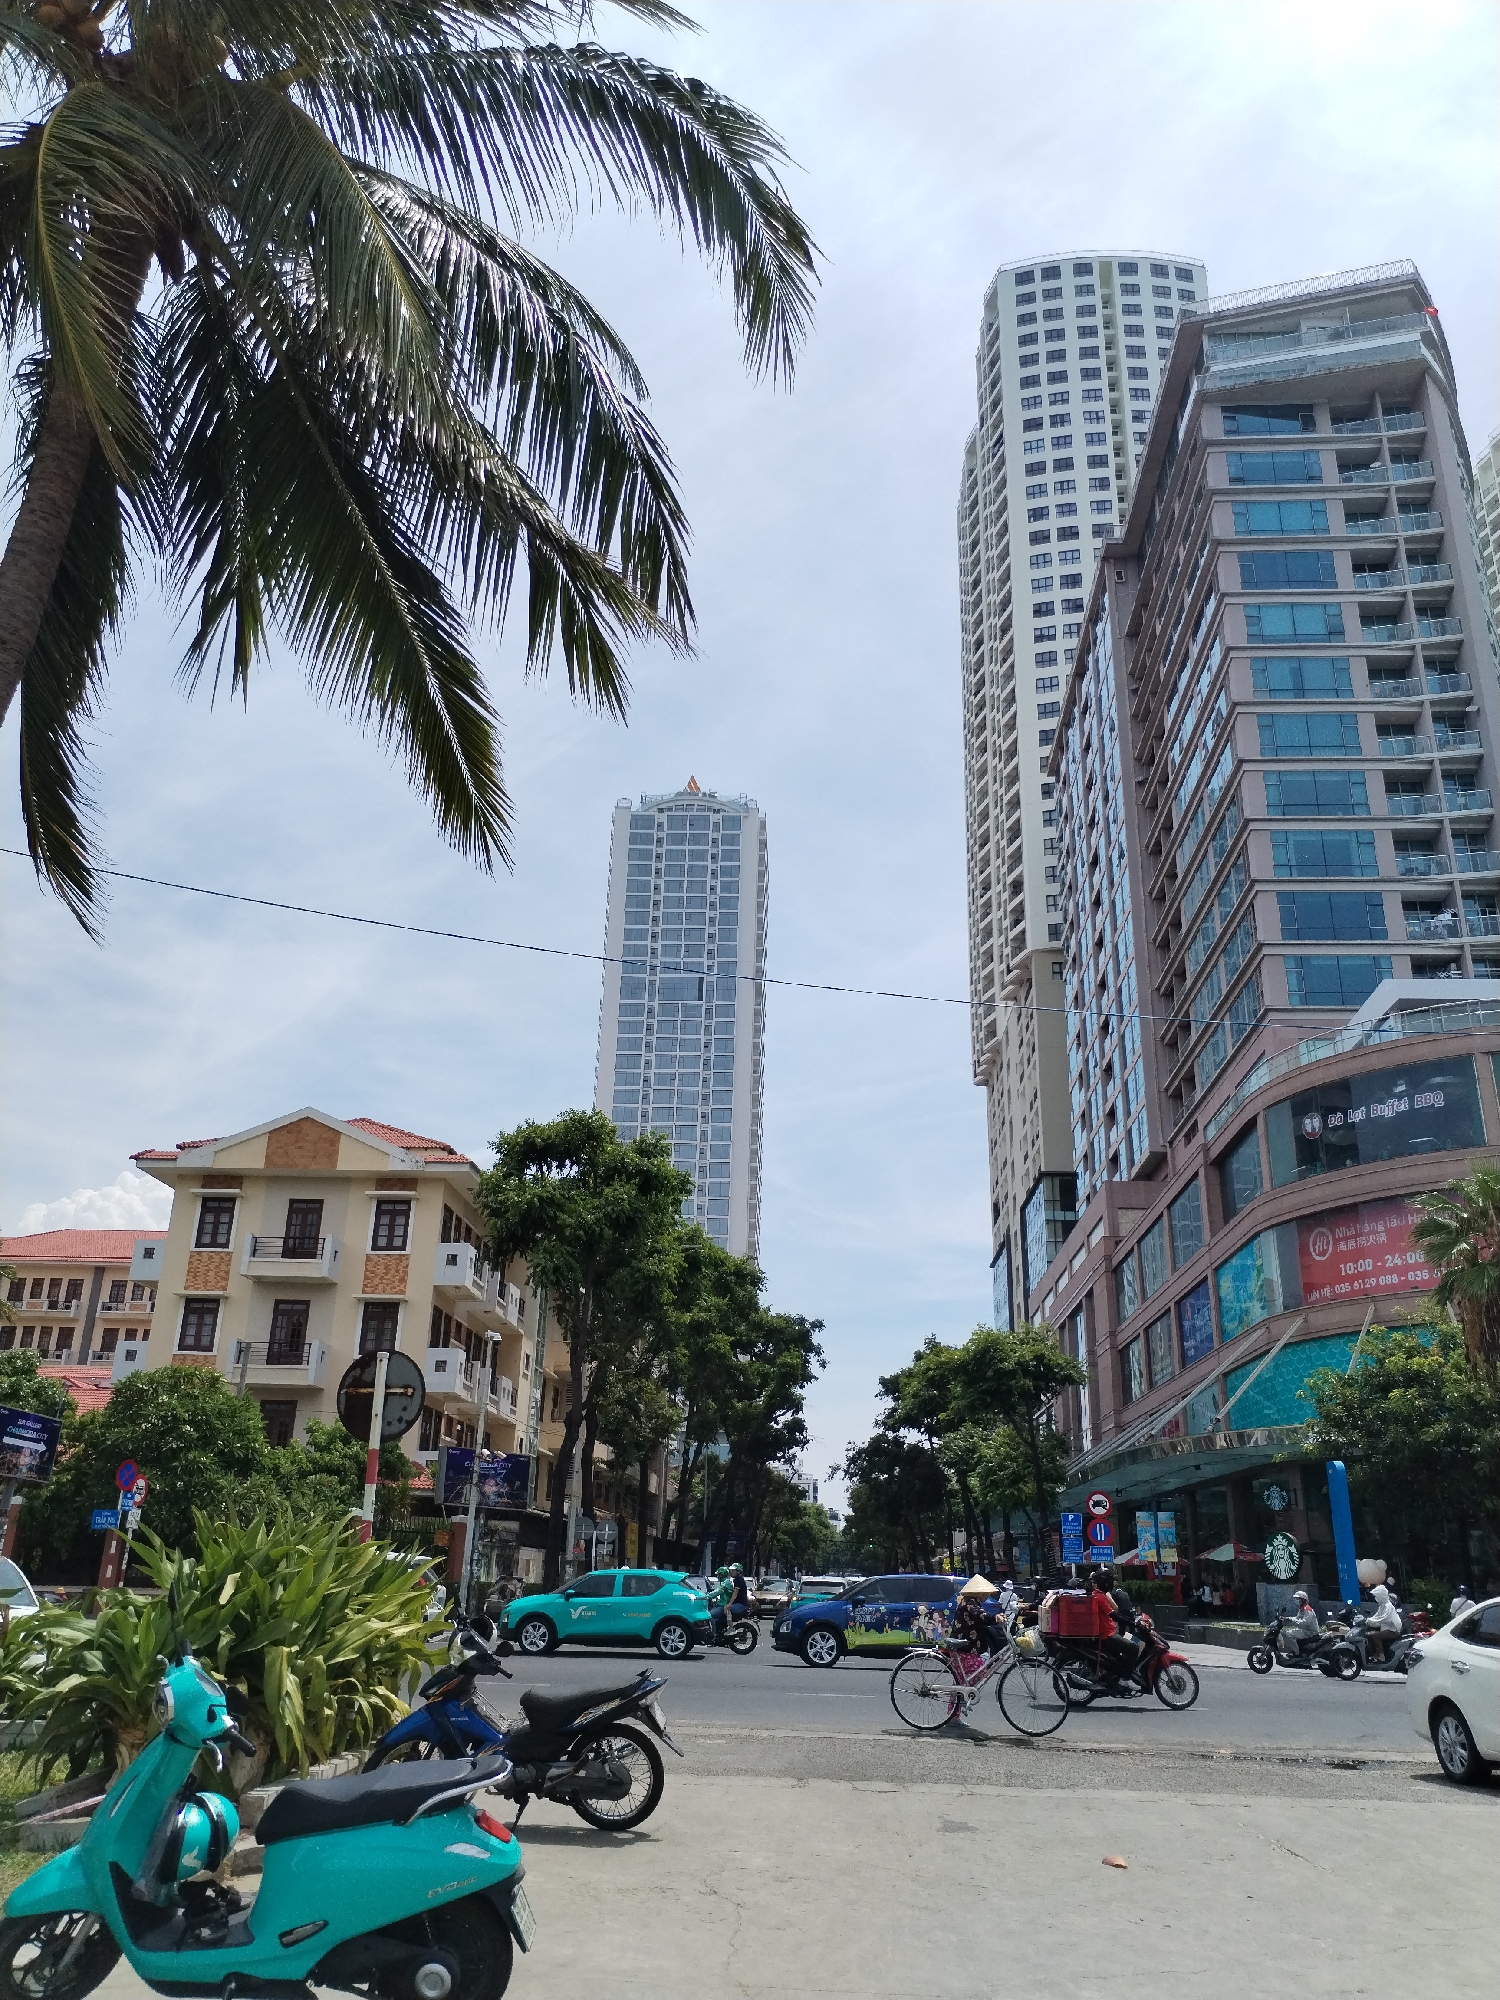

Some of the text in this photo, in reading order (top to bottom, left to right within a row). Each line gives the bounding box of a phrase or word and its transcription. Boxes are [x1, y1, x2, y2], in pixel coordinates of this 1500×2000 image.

[1328, 1091, 1445, 1127] Đà Lạt Buffet BBQ
[1340, 1258, 1373, 1276] 10:00
[1385, 1250, 1425, 1268] 24:00
[1334, 1282, 1352, 1294] 035
